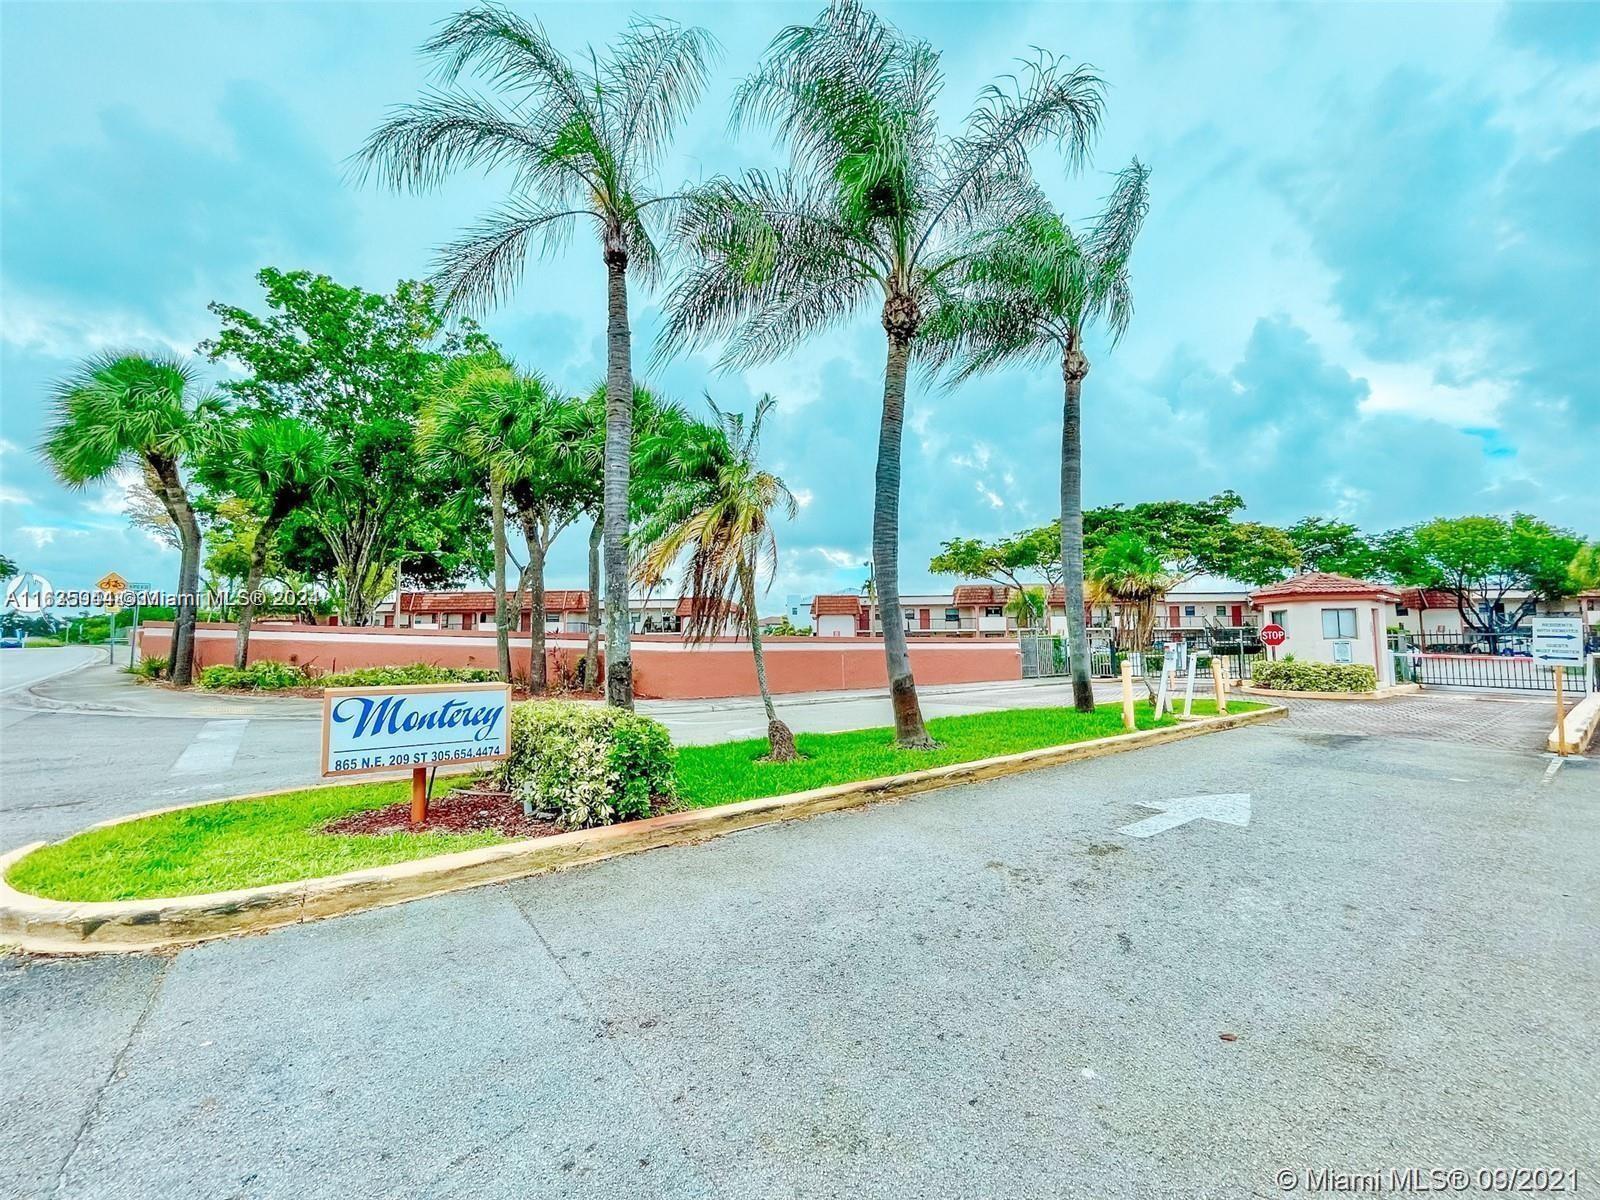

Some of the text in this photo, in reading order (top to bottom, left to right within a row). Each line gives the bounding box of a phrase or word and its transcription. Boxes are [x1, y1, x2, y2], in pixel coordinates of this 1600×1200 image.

[1262, 630, 1284, 640] STOP
[332, 695, 504, 742] Monterey
[335, 745, 500, 771] 865 N.E. 209 ST 305.654.4474
